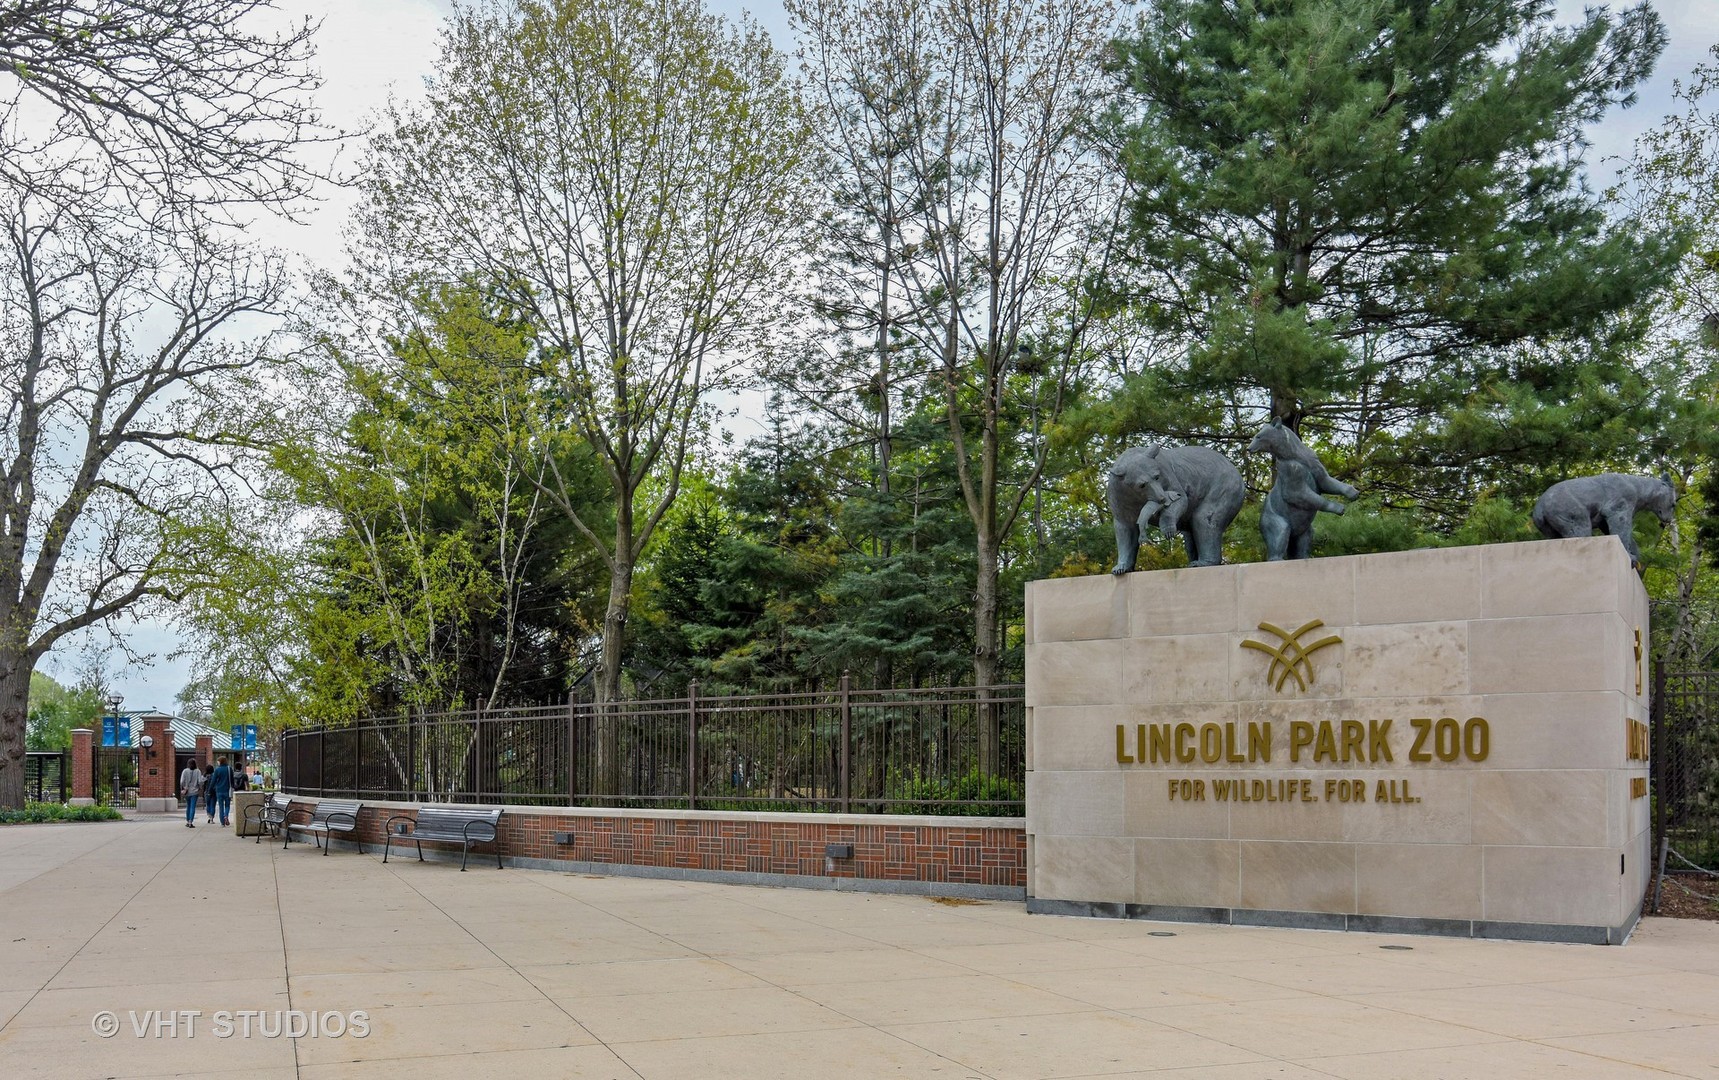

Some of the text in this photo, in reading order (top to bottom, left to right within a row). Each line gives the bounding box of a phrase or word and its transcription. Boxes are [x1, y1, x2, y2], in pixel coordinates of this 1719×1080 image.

[1116, 717, 1490, 763] LINCOLN PARK ZOO
[1168, 779, 1421, 803] FOR WILDLIFE. FOR ALL.
